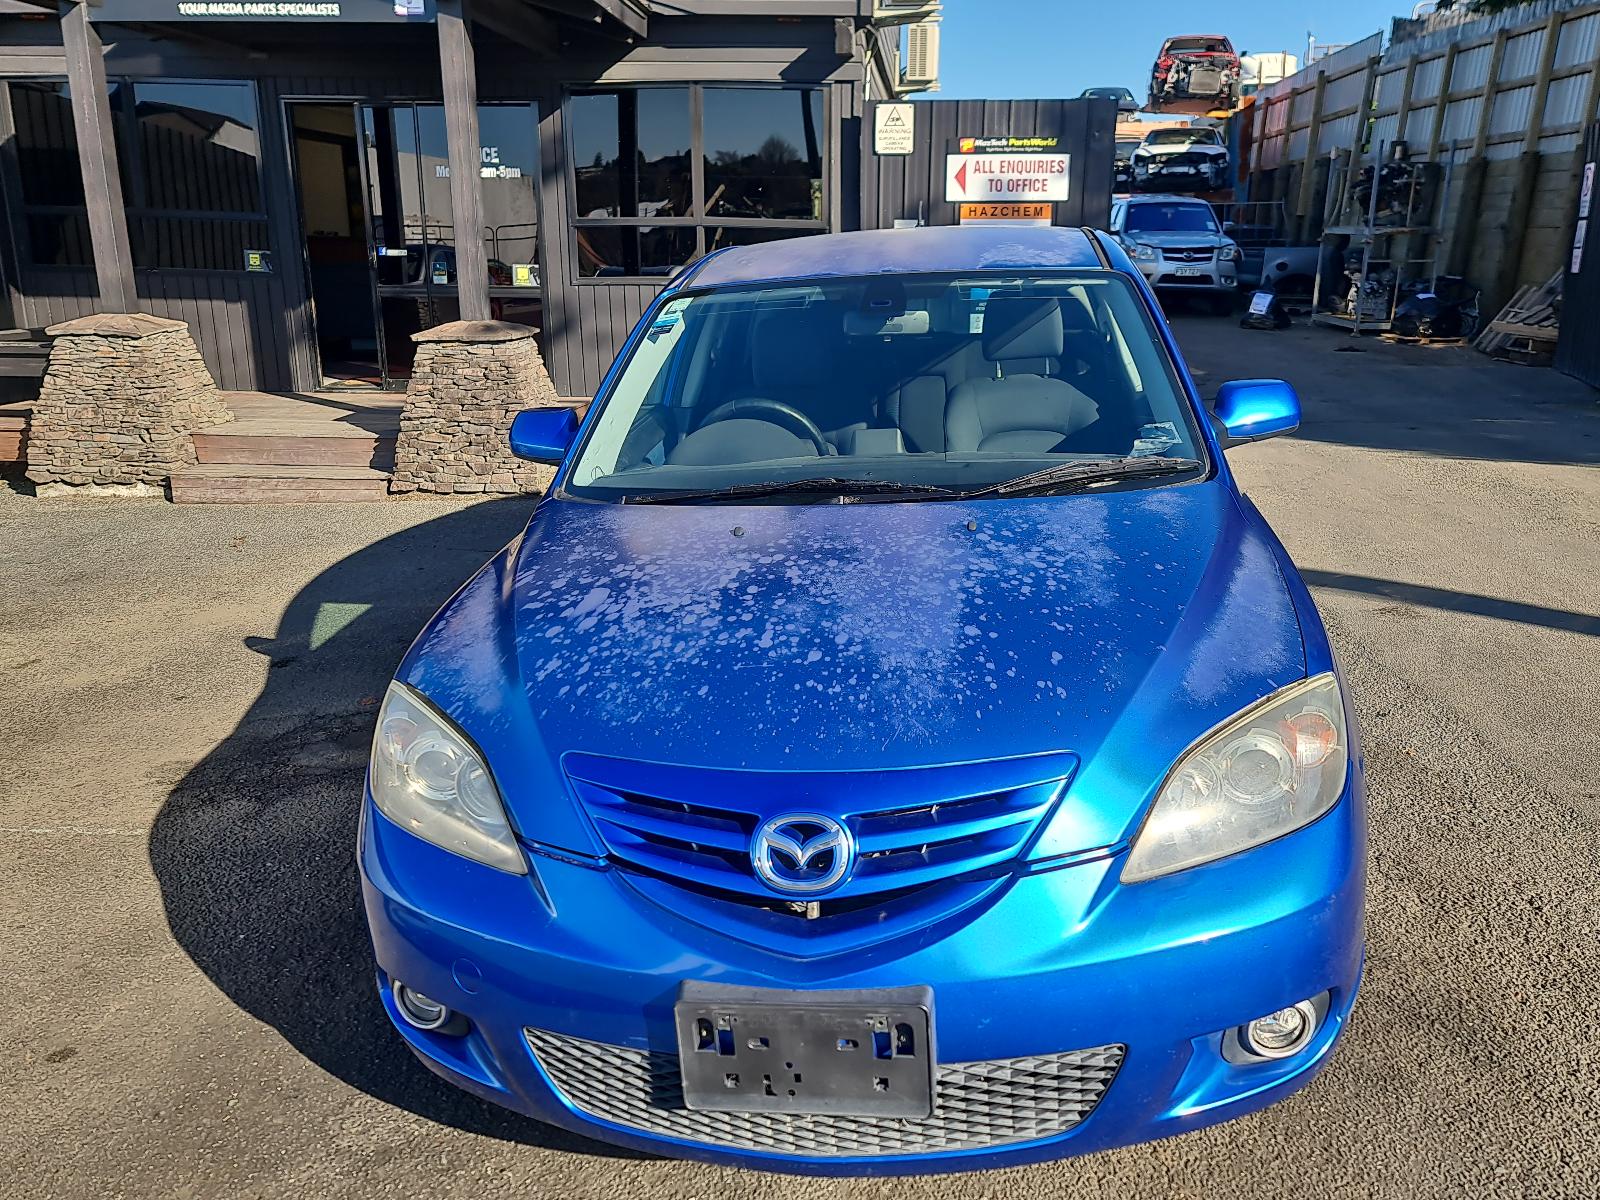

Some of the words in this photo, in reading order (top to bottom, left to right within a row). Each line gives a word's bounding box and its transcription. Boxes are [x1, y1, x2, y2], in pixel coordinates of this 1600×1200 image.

[177, 2, 208, 15] YOUR
[208, 2, 244, 15] MAZDA
[244, 2, 276, 15] PARTS
[276, 2, 340, 16] SPECIALISTS
[480, 165, 521, 180] am-5pm
[973, 160, 995, 174] ALL
[999, 160, 1065, 175] ENQUIRIES
[988, 178, 1003, 193] TO
[1007, 178, 1049, 193] OFFICE
[968, 206, 1044, 217] HAZCHEM
